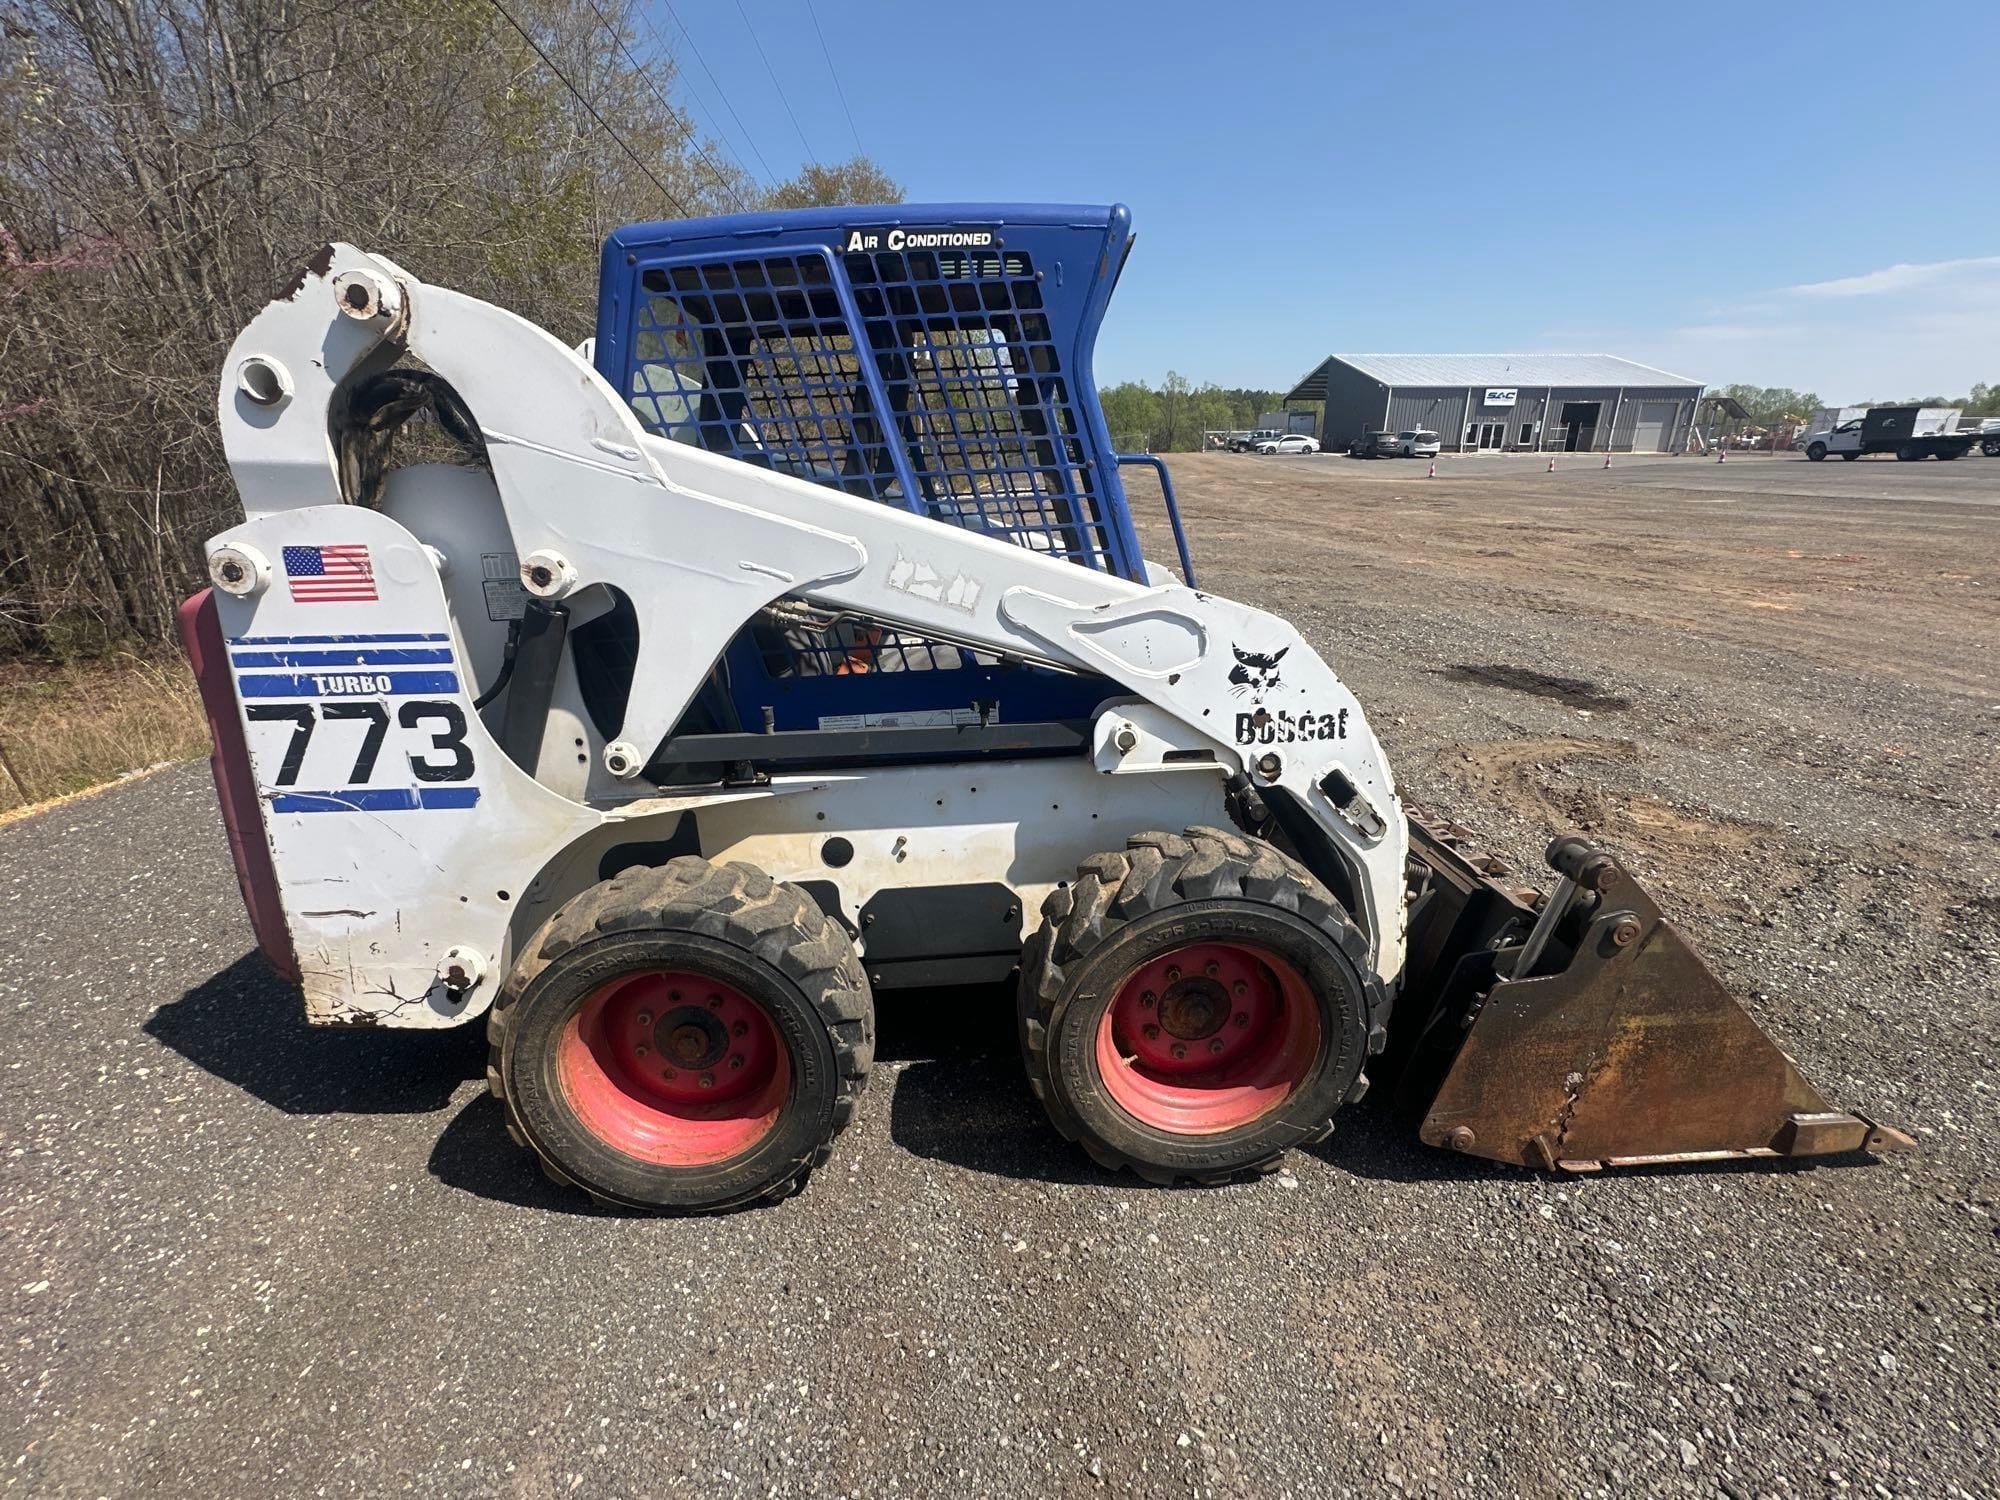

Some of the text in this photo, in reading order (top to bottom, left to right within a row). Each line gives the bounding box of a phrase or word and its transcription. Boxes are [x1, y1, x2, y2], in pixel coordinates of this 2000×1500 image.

[312, 675, 392, 694] TURBO
[245, 700, 476, 786] 773
[1235, 707, 1349, 745] Bobcat
